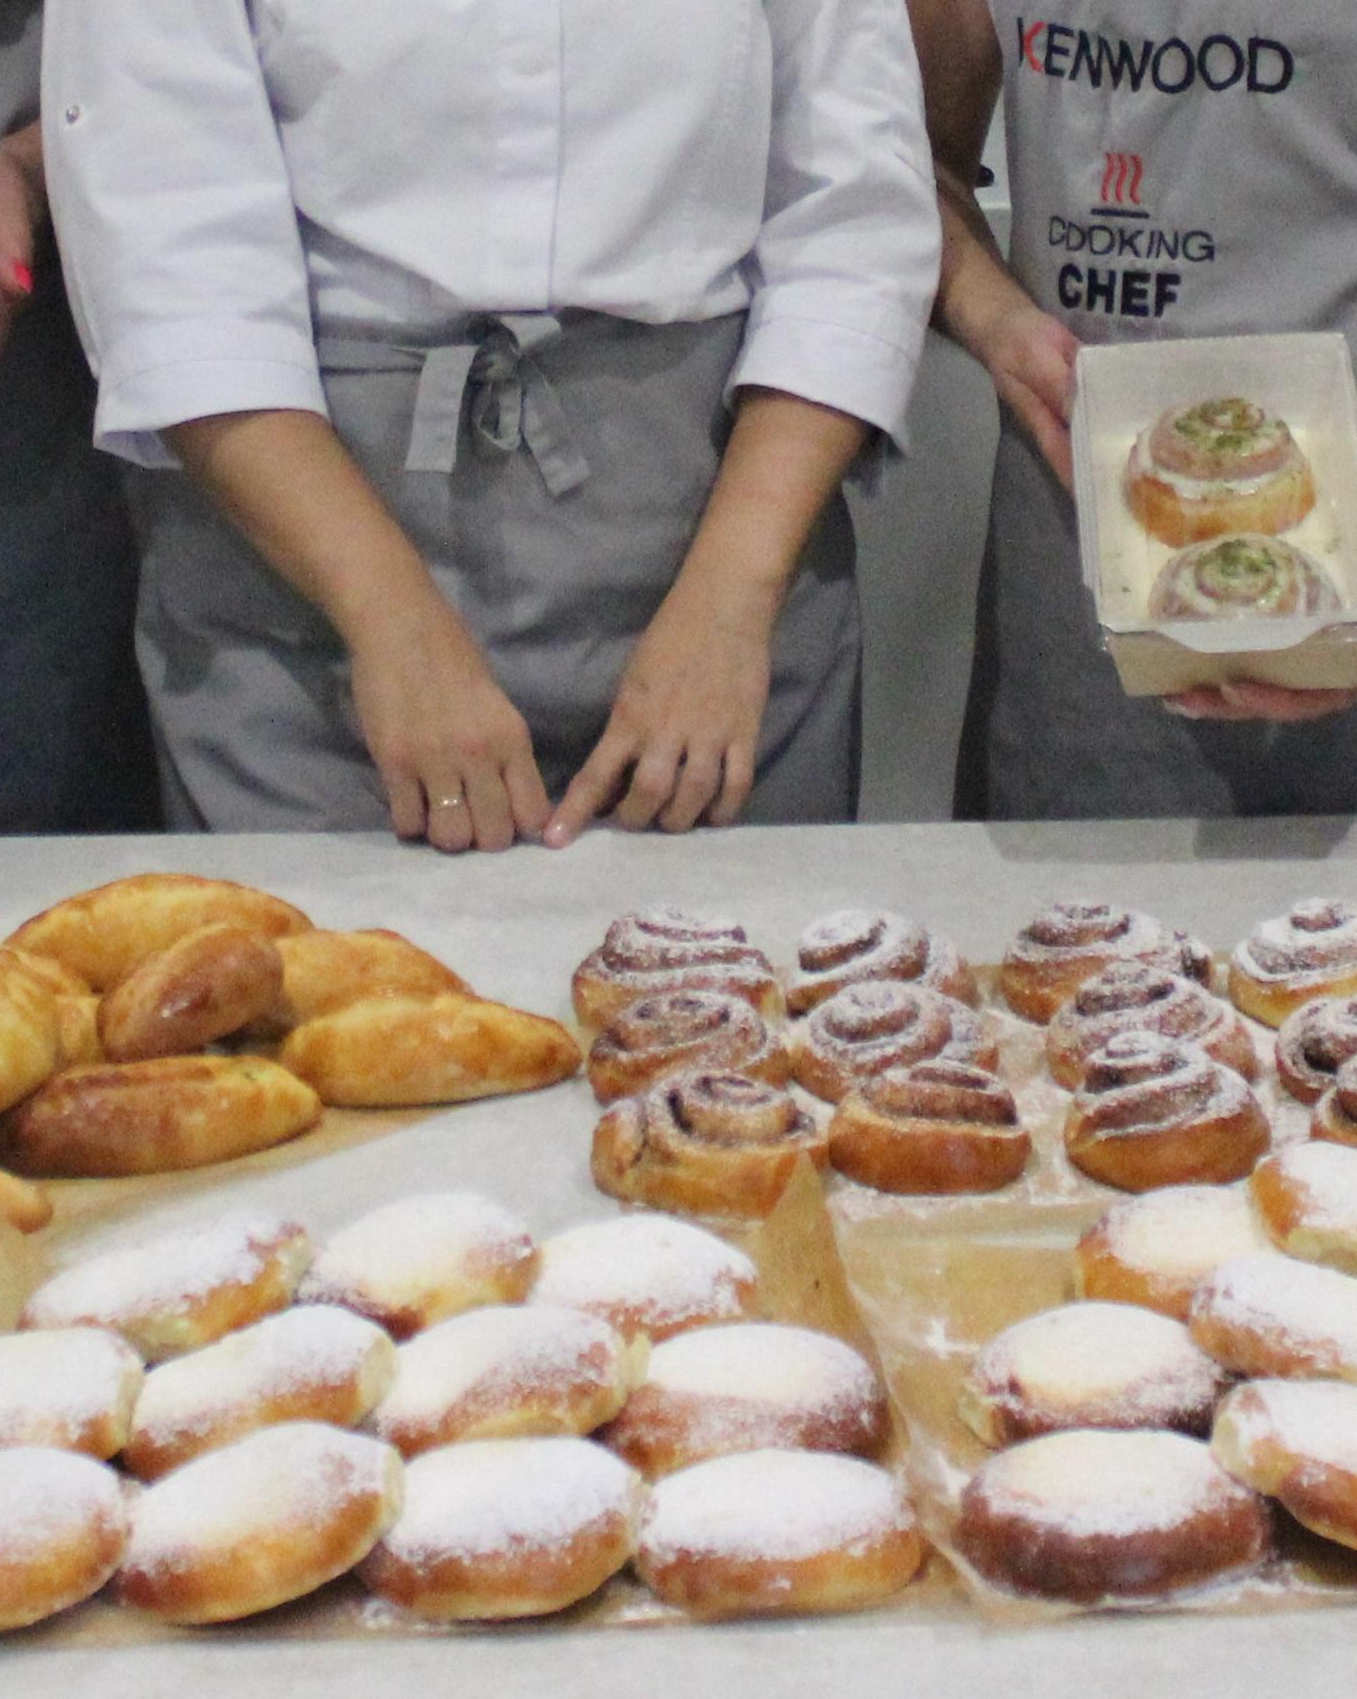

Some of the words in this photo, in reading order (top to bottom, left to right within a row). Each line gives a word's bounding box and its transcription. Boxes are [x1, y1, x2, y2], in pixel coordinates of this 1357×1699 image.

[1016, 16, 1294, 94] KENWOOD
[1048, 215, 1215, 262] COOKING
[1058, 263, 1182, 318] CHEF
